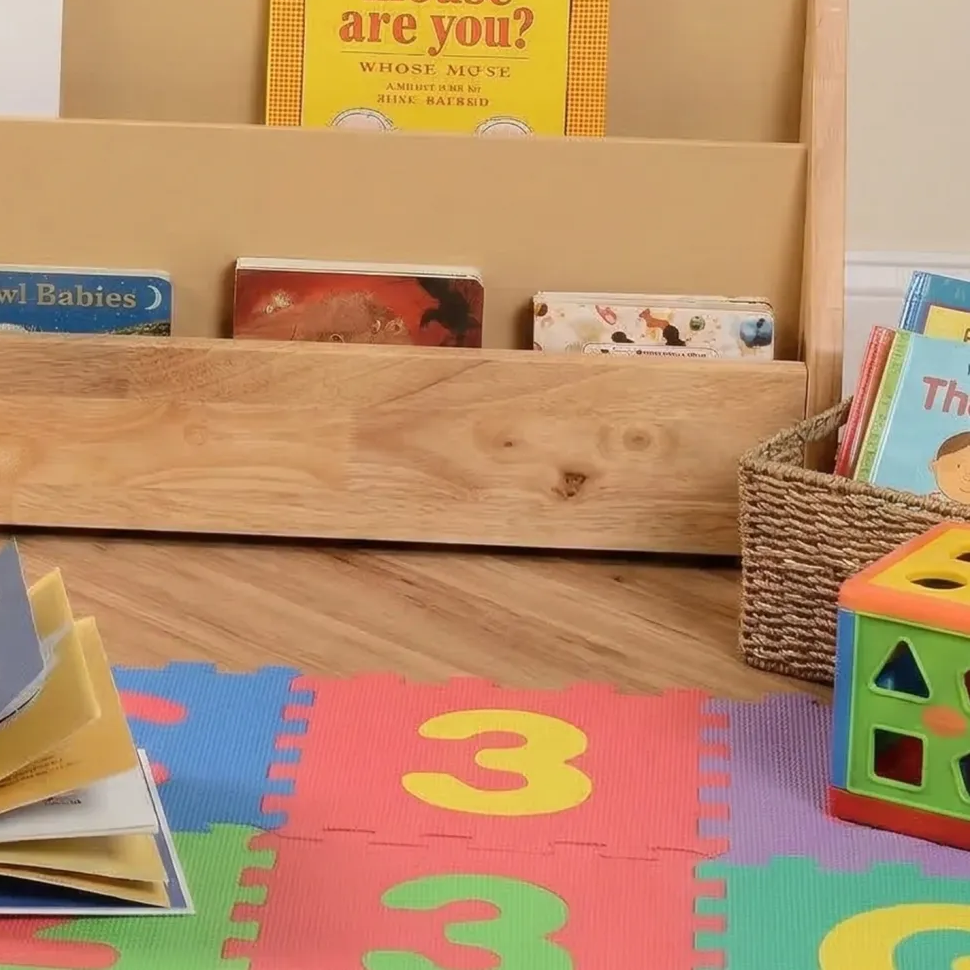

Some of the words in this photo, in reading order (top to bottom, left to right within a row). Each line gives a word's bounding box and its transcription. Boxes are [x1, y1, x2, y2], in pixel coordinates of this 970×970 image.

[338, 10, 418, 44] are
[428, 7, 534, 57] you?
[360, 62, 436, 75] WHOSE
[36, 282, 137, 309] Babies
[923, 376, 970, 416] Th
[401, 709, 592, 817] 3
[362, 873, 572, 970] 3
